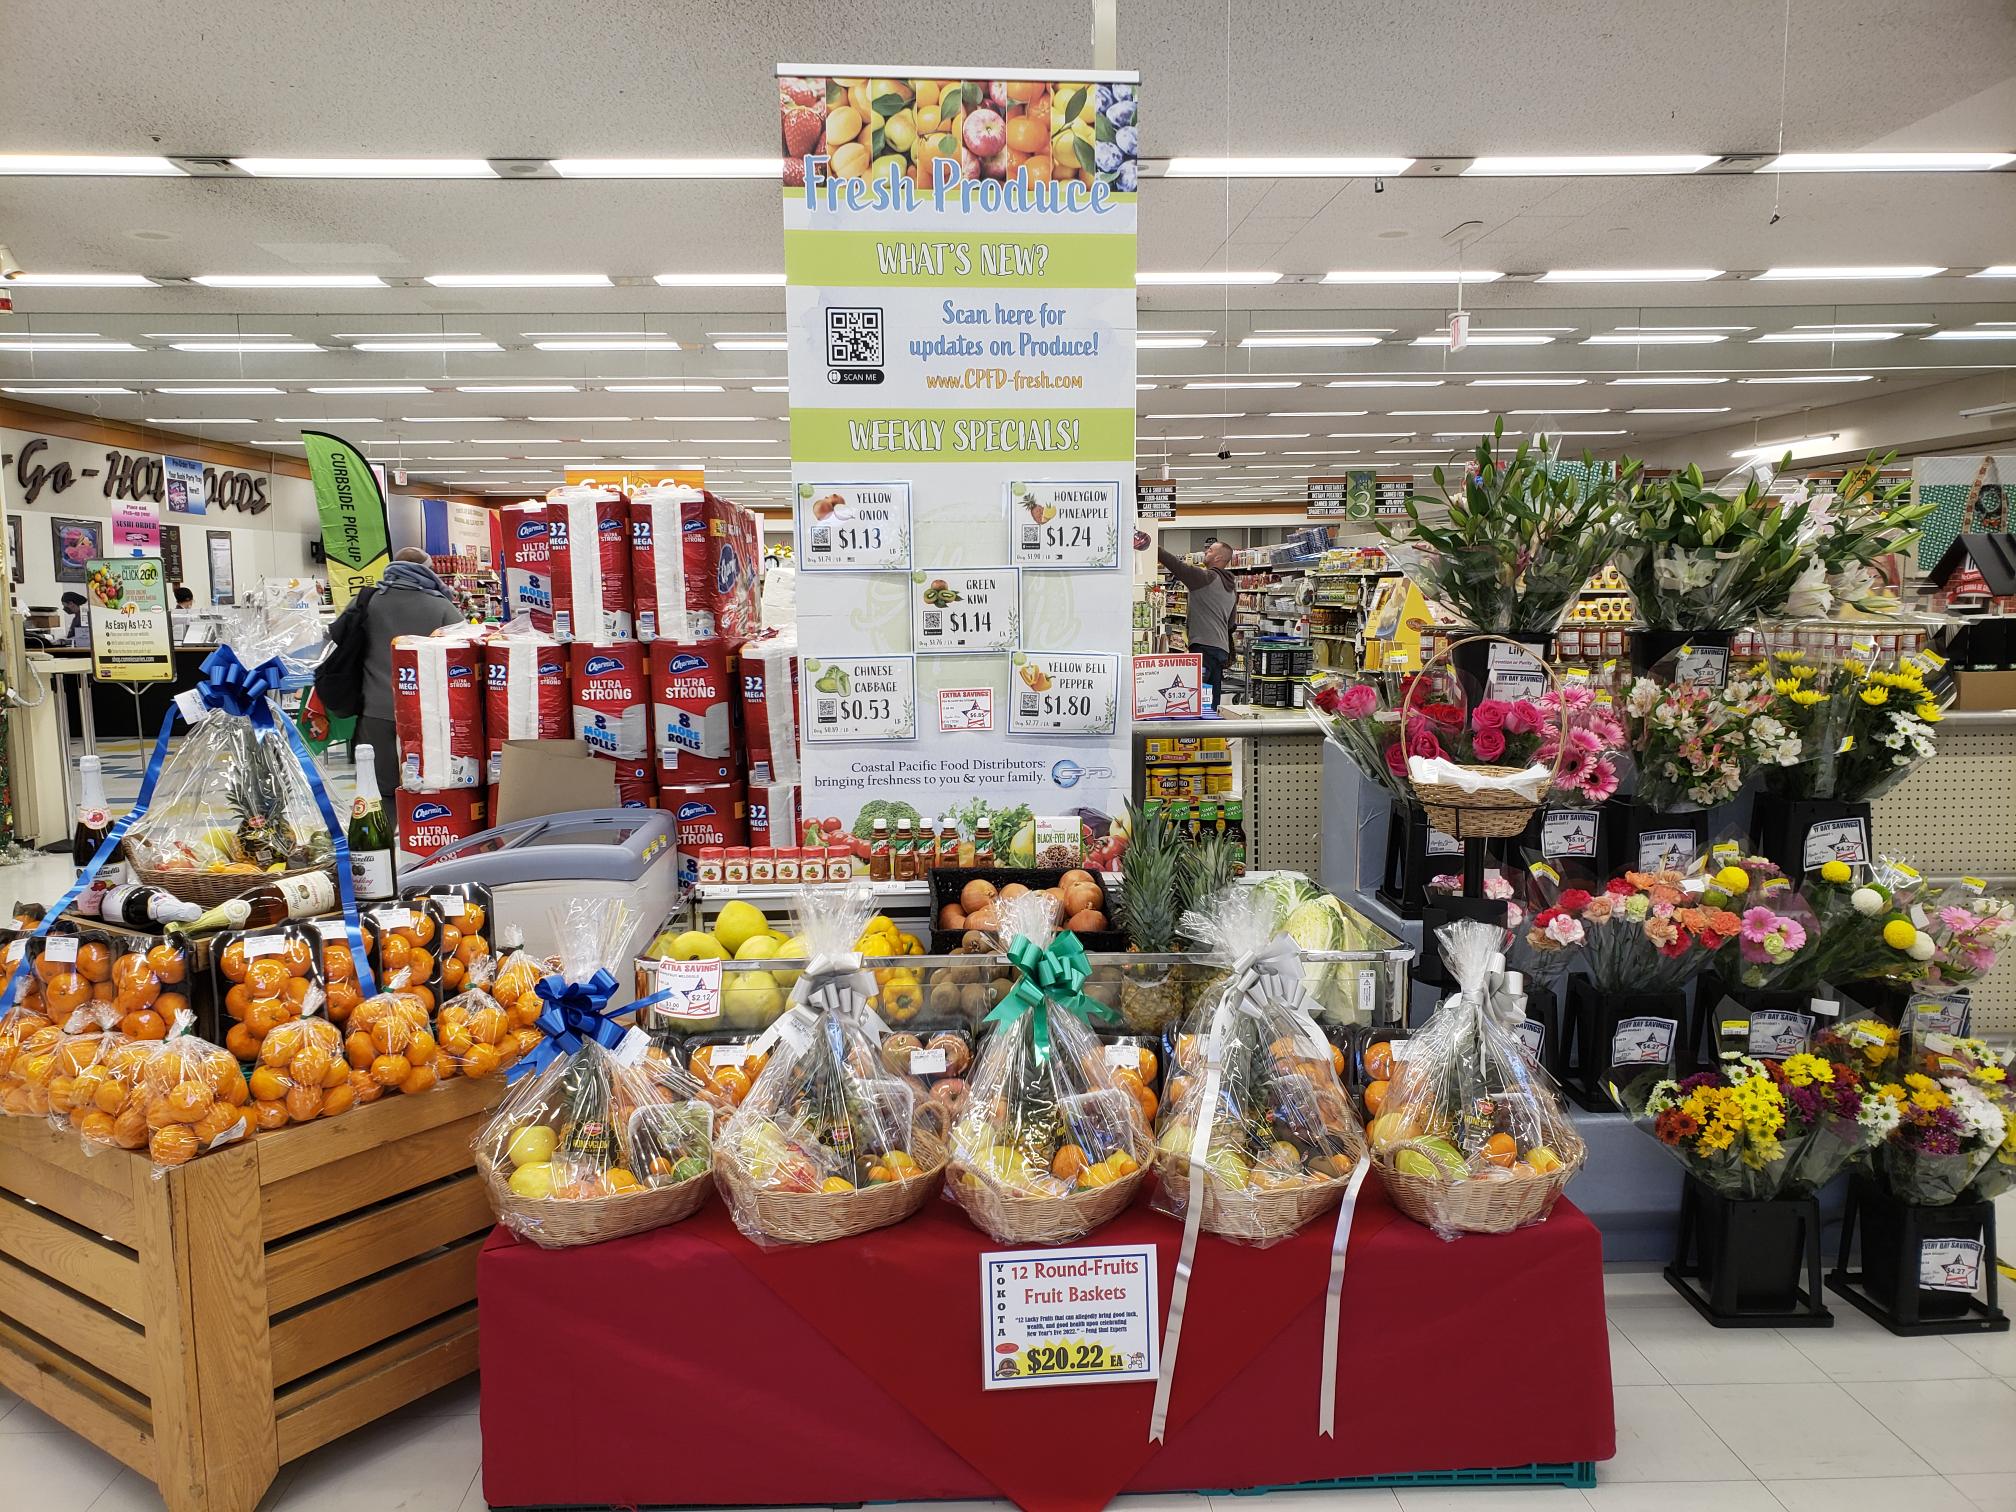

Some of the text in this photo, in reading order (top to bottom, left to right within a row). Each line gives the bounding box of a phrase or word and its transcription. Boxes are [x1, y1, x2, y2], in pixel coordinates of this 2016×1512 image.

[803, 154, 1118, 214] Fresh Produce
[876, 242, 1049, 276] WHAT'S NEW?
[942, 300, 1066, 328] Scan here for
[909, 332, 1098, 361] updates on Produce!
[843, 373, 878, 382] SCAN ME
[926, 368, 1084, 392] www.CPFD-fresh.com
[849, 420, 1080, 451] WEEKLY SPECIALS!
[330, 452, 355, 511] CURBSIDE
[204, 467, 271, 515] OODS
[1054, 490, 1108, 502] HONEYGLOW
[856, 492, 892, 504] YELLOW
[1351, 491, 1371, 518] 3
[859, 509, 889, 521] ONION
[1059, 507, 1109, 519] PINEAPPLE
[519, 521, 547, 536] Charmin
[549, 522, 567, 536] 32
[633, 522, 650, 537] 32
[342, 514, 362, 563] PICK-UP
[838, 527, 882, 550] $1.13
[1046, 525, 1091, 547] $1.24
[515, 551, 550, 562] STRON
[528, 574, 540, 587] 8
[966, 579, 996, 590] GREEN
[519, 585, 549, 600] MORE
[967, 594, 988, 604] KIWI
[519, 594, 551, 609] ROLLS
[120, 602, 135, 617] 24/7
[105, 620, 152, 631] As Easy As 1-2-3
[950, 611, 991, 634] $1.14
[1508, 646, 1524, 657] Lily
[587, 659, 615, 672] Charmin
[671, 657, 699, 670] Charmin
[1048, 662, 1107, 674] YELLOW BELL
[1135, 658, 1198, 669] EXTRA SAVINGS
[398, 667, 416, 682] 32
[488, 665, 506, 679] 32
[854, 665, 894, 676] CHINESE
[590, 680, 621, 689] ULTRA
[674, 678, 706, 687] ULTRA
[745, 676, 763, 689] 32
[854, 681, 898, 693] CABBAGE
[1059, 678, 1093, 690] PEPPER
[581, 688, 632, 700] STRONG
[665, 686, 716, 698] STRONG
[1168, 691, 1186, 699] $1.32
[840, 699, 890, 720] $0.53
[1043, 694, 1091, 716] $1.80
[595, 714, 607, 729] 8
[679, 713, 690, 728] 8
[584, 726, 617, 742] MORE
[667, 723, 701, 740] MORE
[851, 758, 1046, 773] Coastal Pacific Food Distributors:
[814, 771, 1046, 789] bringing freshness to you & your family.
[415, 805, 443, 818] Charmin
[681, 804, 707, 817] Charmin
[750, 805, 767, 818] 32
[682, 825, 713, 834] ULTRA
[750, 819, 768, 827] MEGA
[1831, 821, 1858, 830] SAVINGS
[416, 826, 449, 835] ULTRA
[1667, 832, 1692, 840] SAVINGS
[409, 835, 459, 847] STRONG
[677, 833, 724, 844] STRONG
[1037, 832, 1079, 843] BLACK-EYED PEAS
[685, 964, 718, 972] SAVINGS
[1644, 1021, 1671, 1031] SAVINGS
[1950, 1242, 1979, 1251] SAVINGS
[1011, 1258, 1139, 1280] 12 Round-Fruits
[996, 1264, 1007, 1337] YOKOTA
[1024, 1285, 1126, 1305] Fruit Baskets
[1075, 1313, 1097, 1321] allegedly
[1027, 1344, 1123, 1373] $20.22 EA
